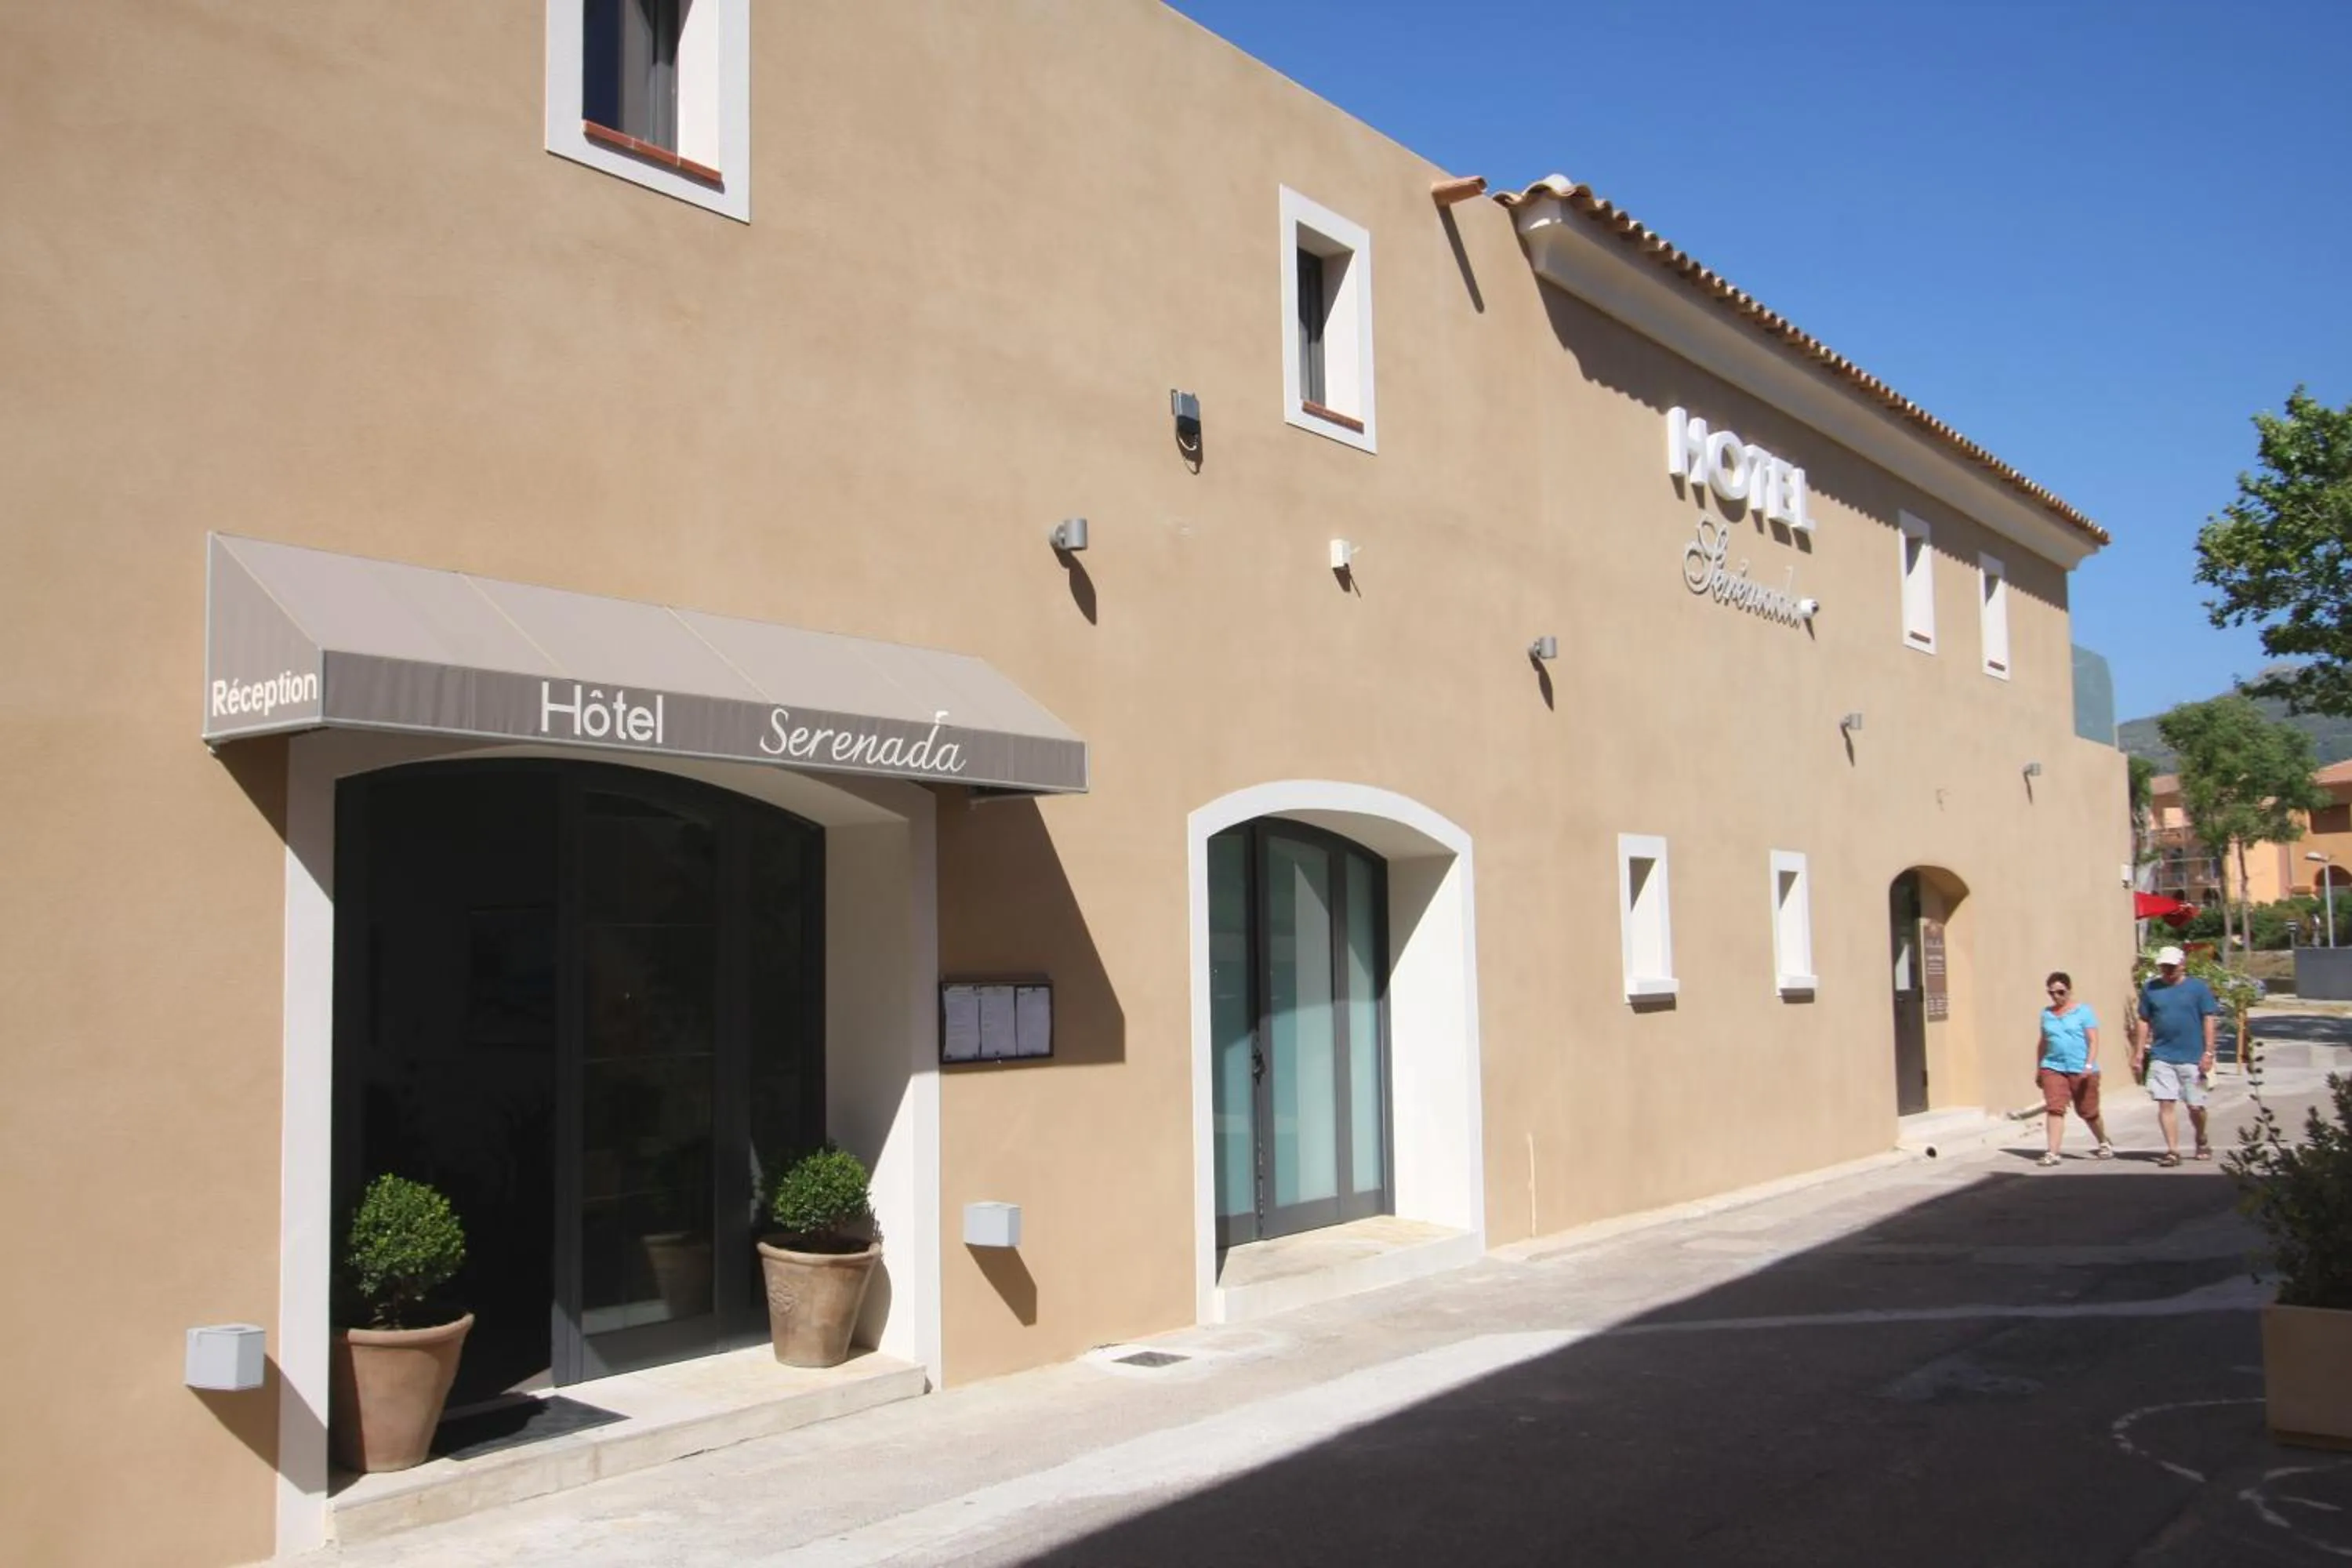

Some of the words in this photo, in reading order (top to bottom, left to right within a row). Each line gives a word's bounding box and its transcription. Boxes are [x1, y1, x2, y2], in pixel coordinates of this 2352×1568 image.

[1668, 406, 1817, 532] HOTEL
[212, 670, 318, 717] Réception
[541, 681, 664, 744] Hôtel
[759, 708, 967, 772] Serenada
